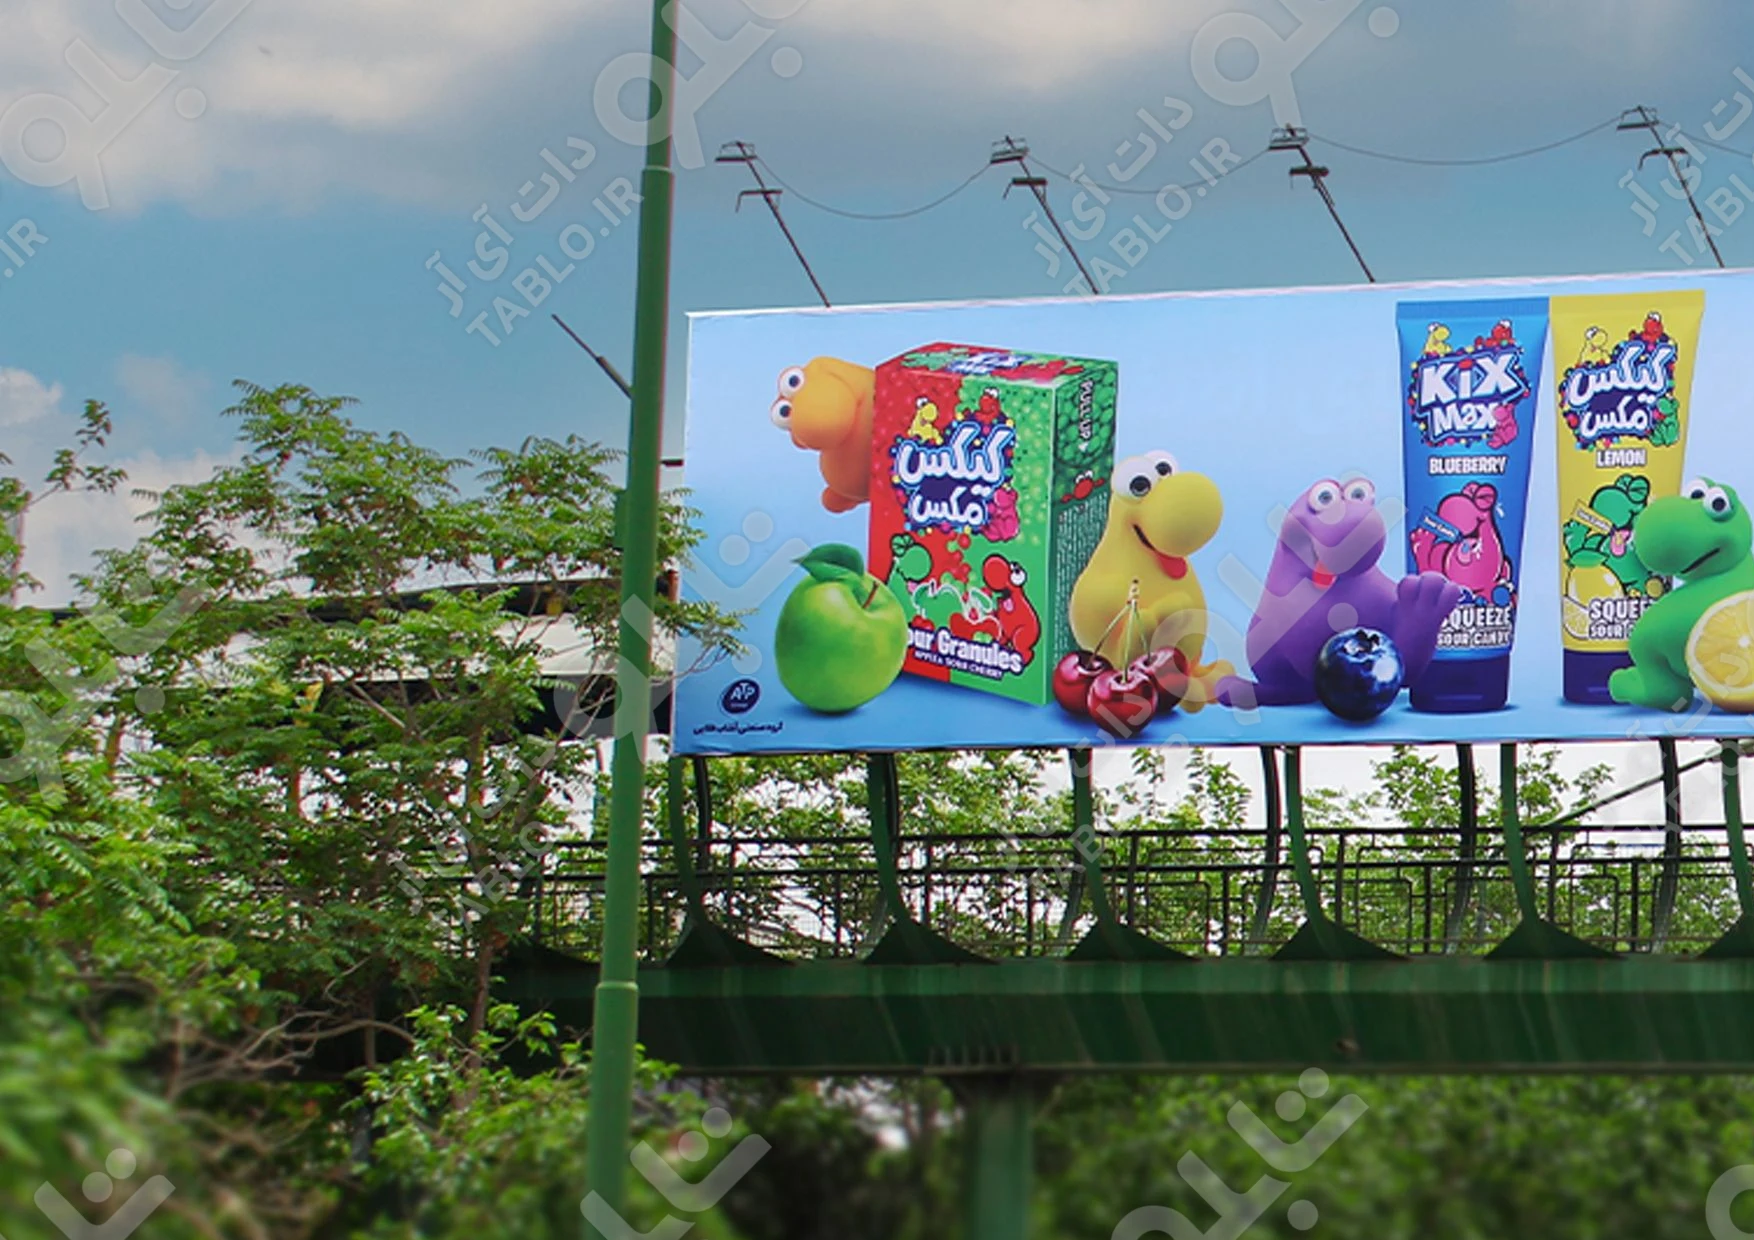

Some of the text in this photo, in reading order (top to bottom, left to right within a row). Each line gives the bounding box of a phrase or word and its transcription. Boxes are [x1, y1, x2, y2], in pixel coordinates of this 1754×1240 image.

[1433, 403, 1498, 434] Max
[1429, 456, 1507, 475] BLUEBERRY
[1596, 449, 1647, 467] LEMON
[1441, 606, 1511, 629] QUEEZE
[908, 628, 1022, 673] our Granules
